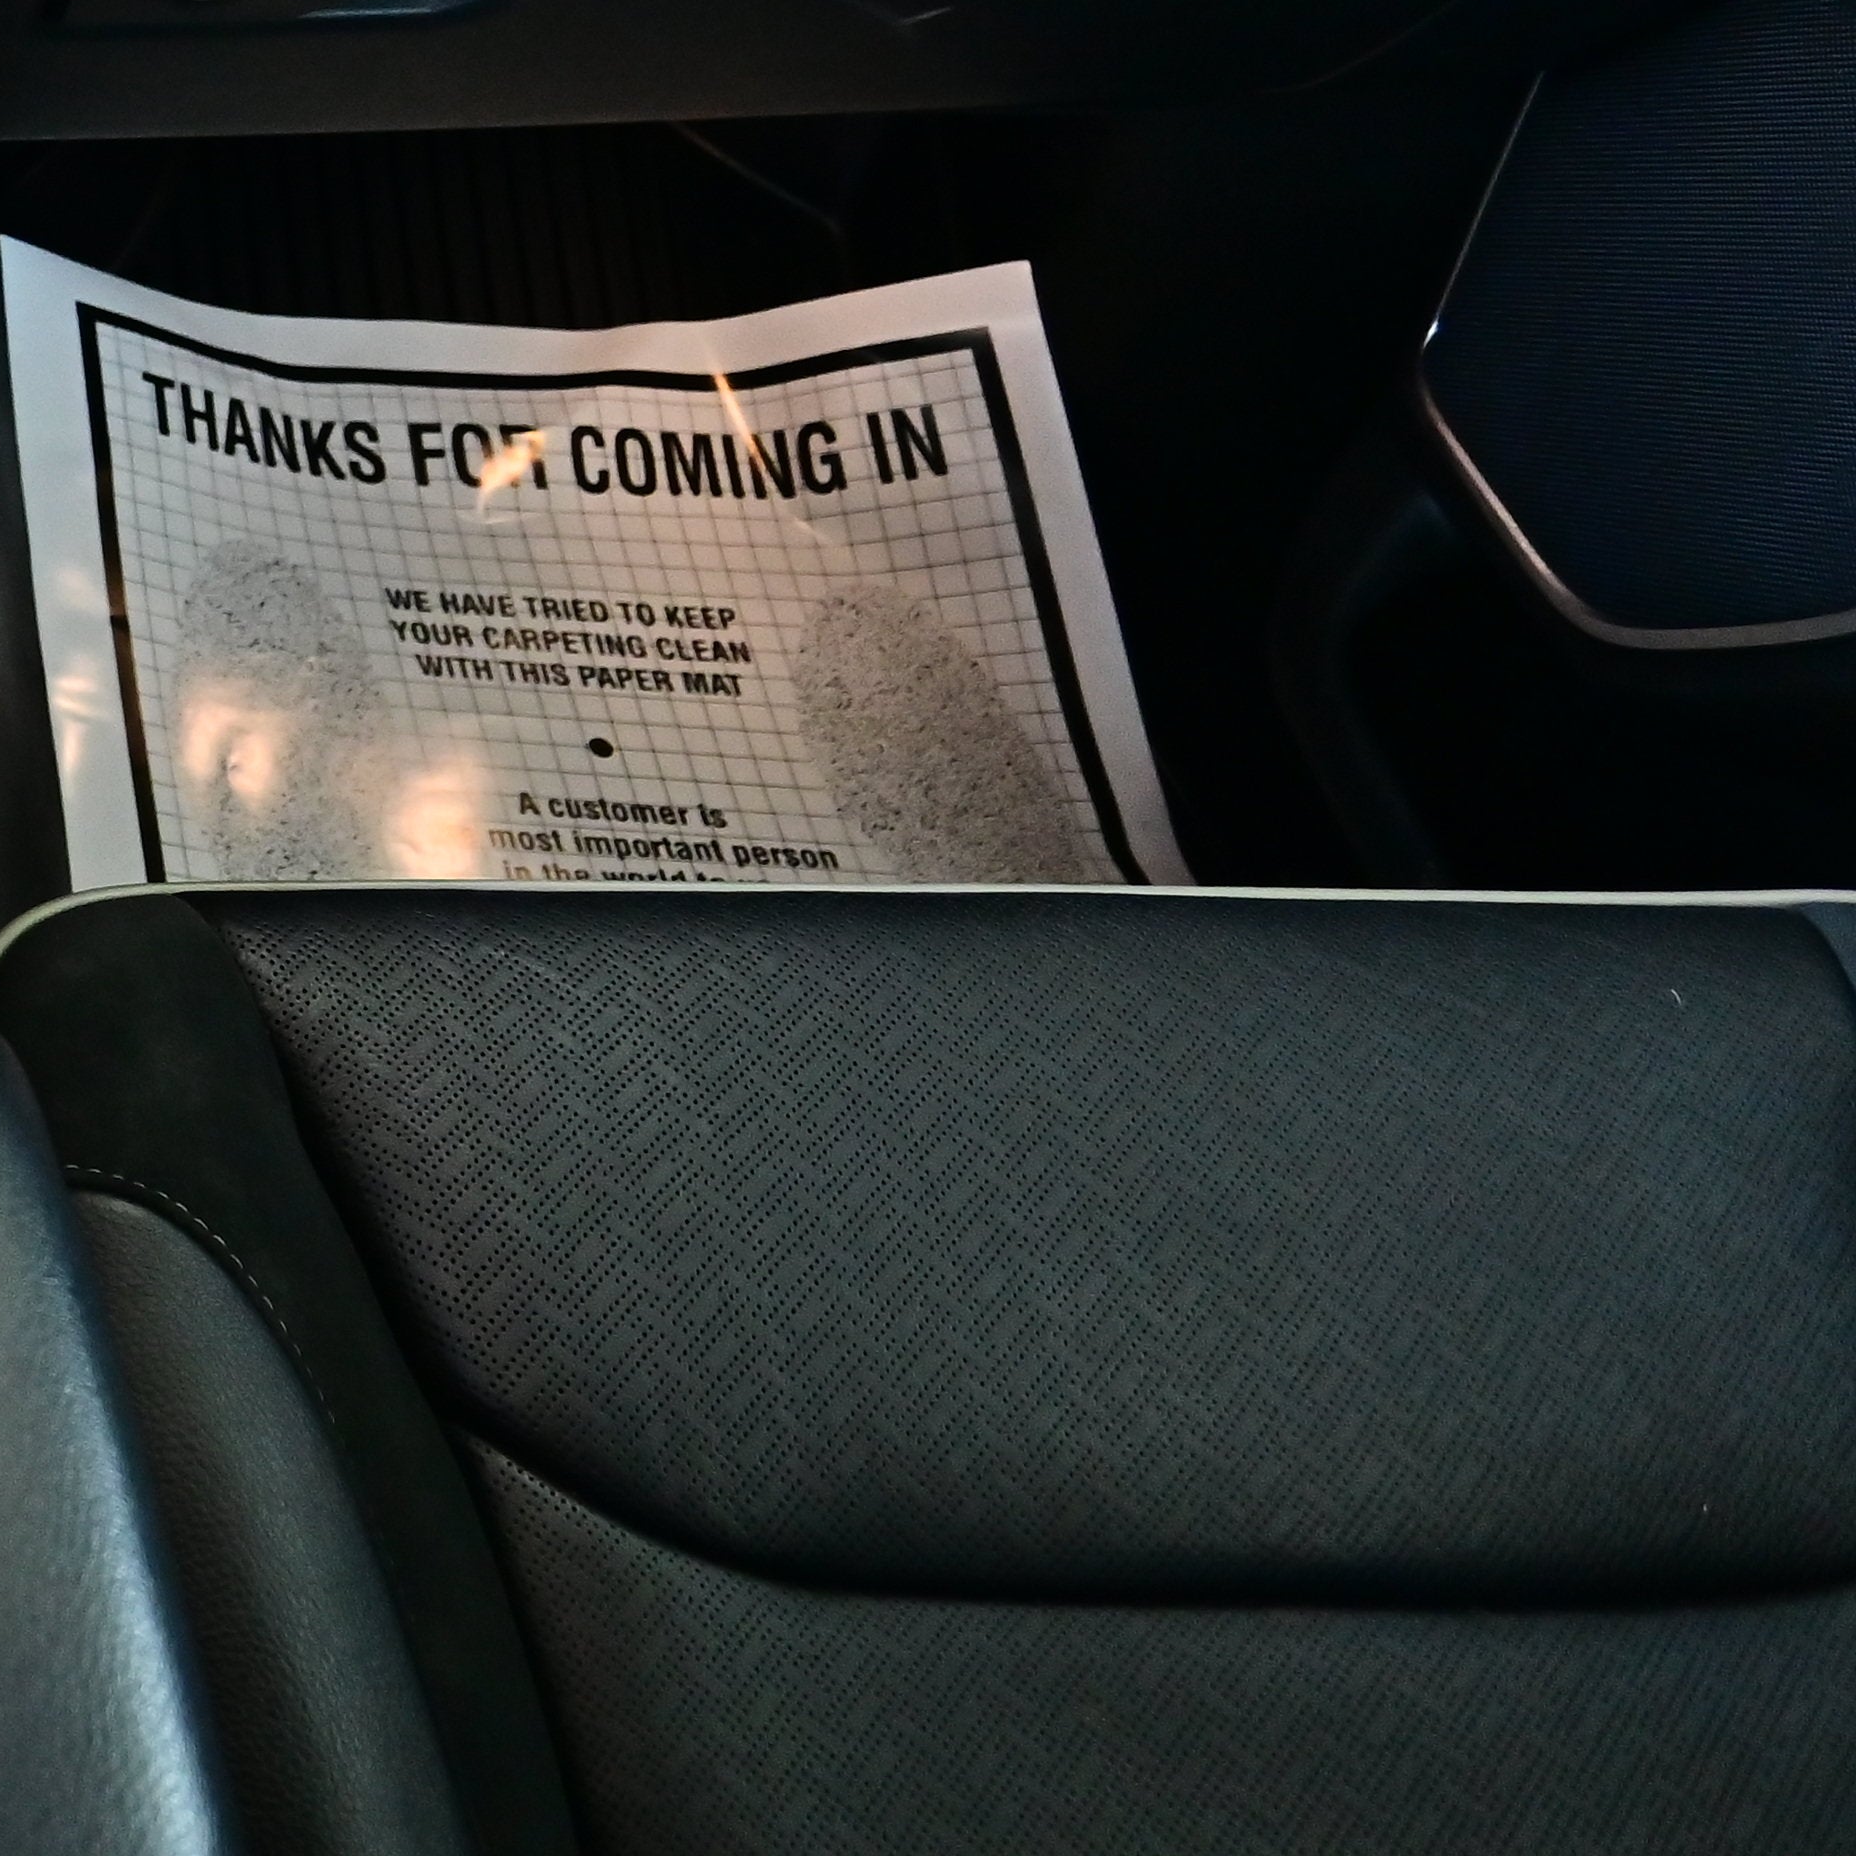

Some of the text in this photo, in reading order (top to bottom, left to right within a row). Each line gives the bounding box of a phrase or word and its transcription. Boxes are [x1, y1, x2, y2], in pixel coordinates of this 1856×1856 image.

[142, 371, 386, 485] THANKS
[570, 420, 848, 500] COMING
[866, 403, 949, 485] IN
[385, 587, 736, 631] WE HAVE TRIED TO KEEP
[388, 619, 753, 664] YOUR CARPETING CLEAN
[414, 653, 743, 697] WITH THIS PAPER MAT
[519, 792, 729, 829] A customer is
[488, 827, 840, 871] most important person
[502, 860, 533, 881] in
